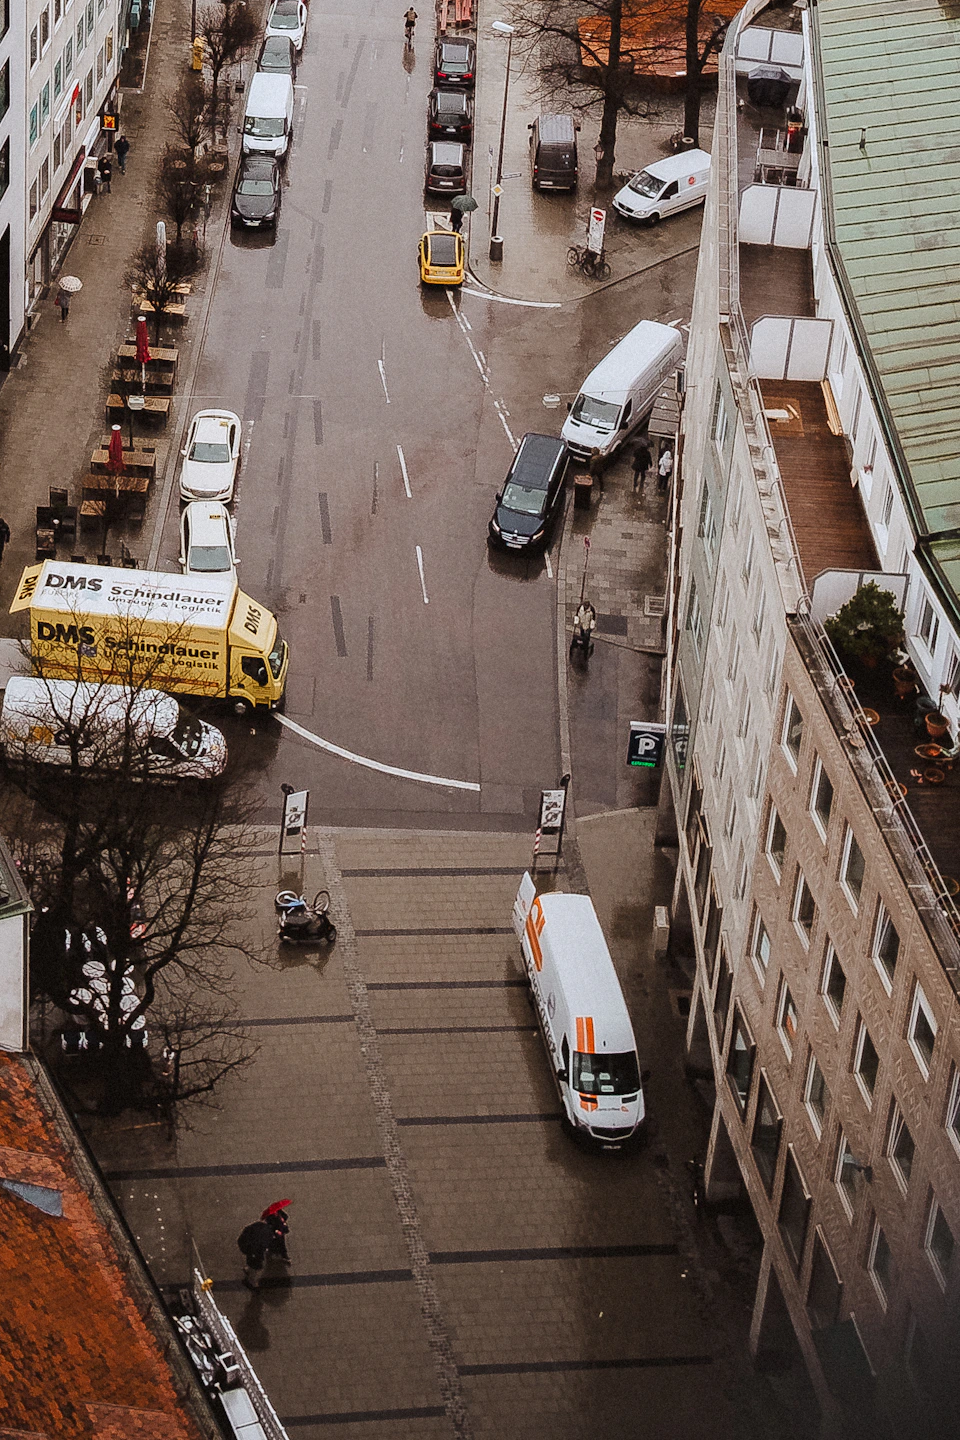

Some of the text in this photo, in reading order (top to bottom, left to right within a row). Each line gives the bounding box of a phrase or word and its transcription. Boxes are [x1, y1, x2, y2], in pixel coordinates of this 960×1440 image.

[18, 574, 39, 601] DMS
[44, 573, 104, 592] DMS
[110, 586, 225, 606] Schindlauer
[175, 603, 221, 613] Logistik
[244, 605, 262, 635] DMS
[37, 621, 95, 645] DMS
[104, 636, 220, 660] Schindlauer
[171, 657, 219, 670] Logistik
[638, 738, 655, 755] P
